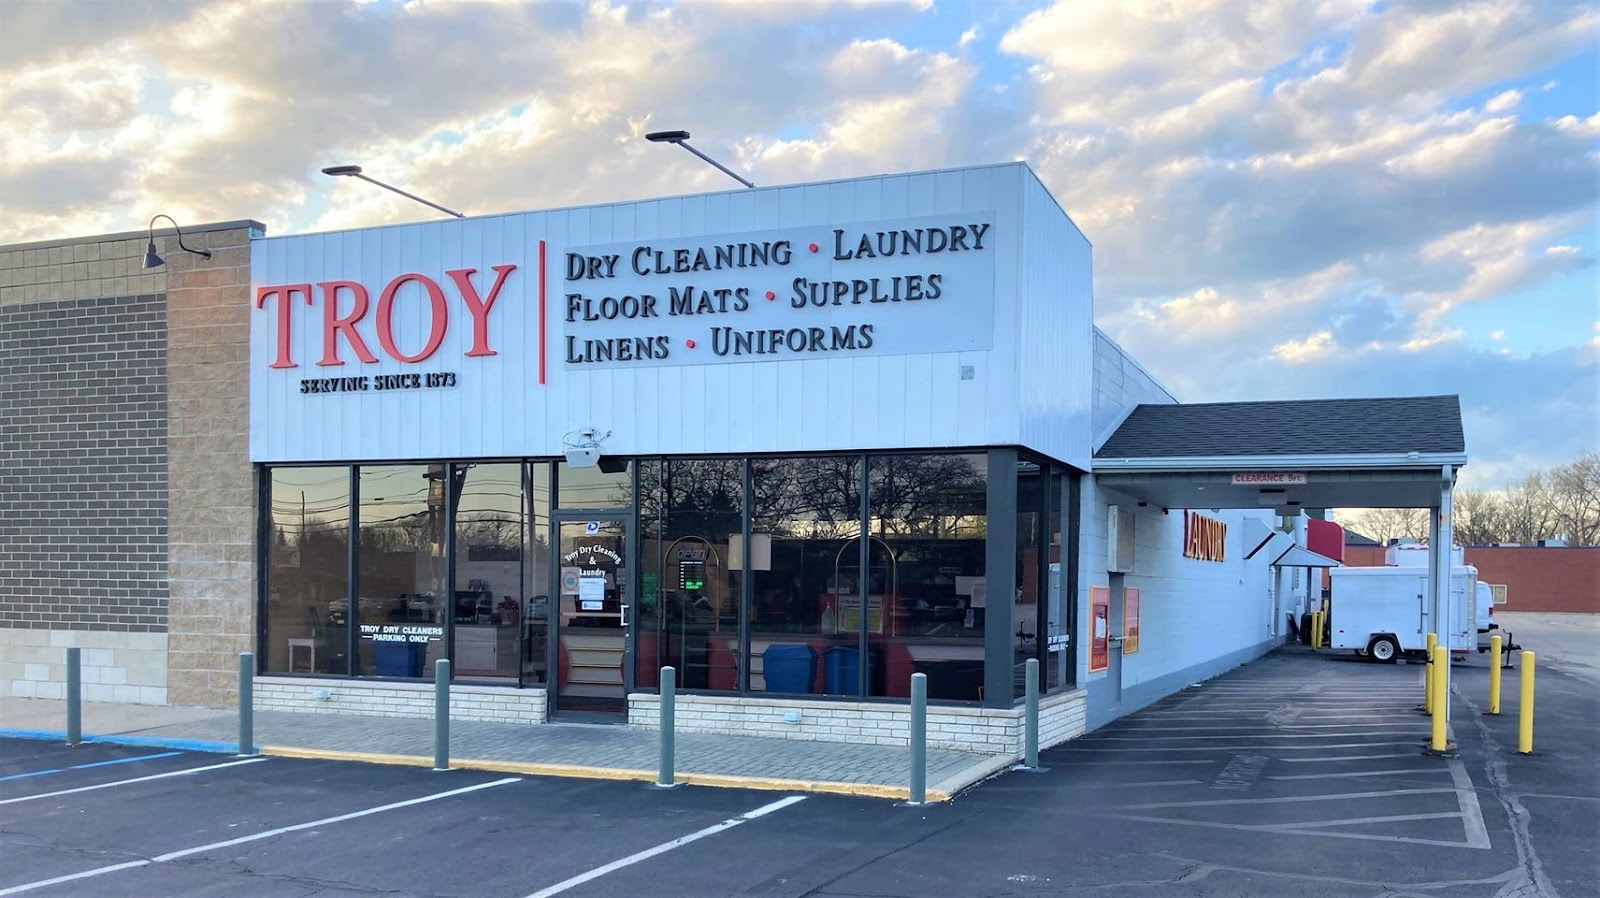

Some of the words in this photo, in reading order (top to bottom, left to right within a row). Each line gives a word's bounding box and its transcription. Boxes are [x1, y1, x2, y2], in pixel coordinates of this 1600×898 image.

[833, 223, 990, 260] LAUNDRY
[565, 252, 620, 281] DRY
[631, 240, 792, 276] CLEANING
[791, 274, 942, 308] SUPPLIES
[256, 264, 518, 369] TROY
[565, 293, 659, 322] FLOOR
[668, 286, 749, 316] MATS
[565, 335, 669, 363] LINENS
[710, 324, 873, 356] UNIFORMS
[300, 376, 369, 394] SERVING
[374, 373, 421, 390] SINCE
[425, 371, 457, 388] 1873
[1235, 474, 1284, 482] CLEARANCE
[564, 550, 579, 562] Troy
[579, 545, 593, 555] Dry
[593, 544, 622, 565] Cleaning
[589, 556, 597, 565] &
[579, 568, 606, 578] Laundry
[360, 625, 380, 633] TROY
[383, 626, 400, 634] DRY
[402, 626, 443, 635] CLEANERS
[372, 633, 406, 642] PARKING
[409, 635, 429, 643] ONLY
